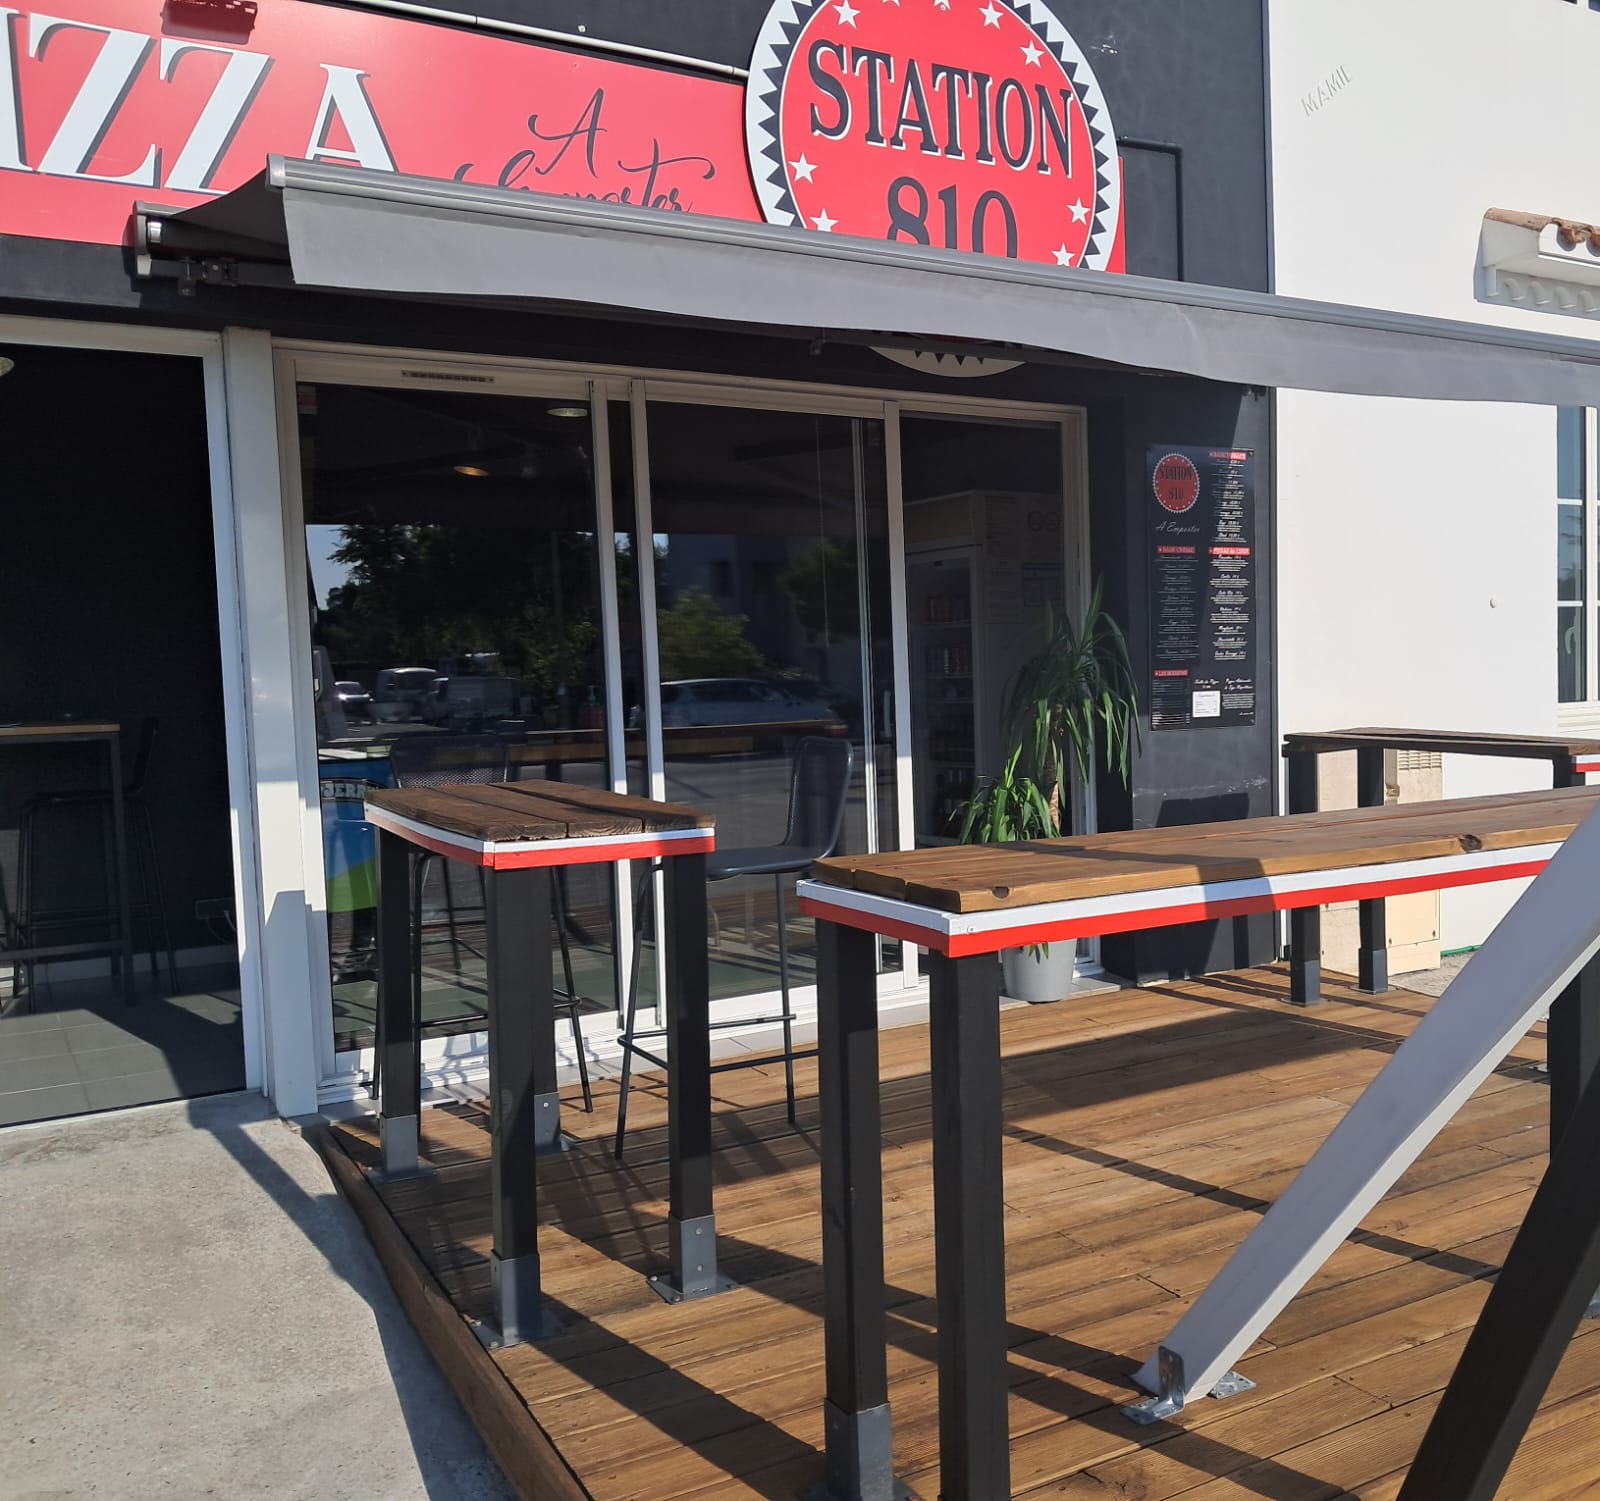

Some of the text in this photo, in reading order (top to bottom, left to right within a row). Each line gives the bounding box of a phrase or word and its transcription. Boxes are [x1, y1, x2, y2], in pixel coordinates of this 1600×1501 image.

[528, 87, 607, 179] A
[808, 38, 1073, 179] STATION
[886, 176, 1018, 259] 810
[323, 783, 369, 799] JERR
